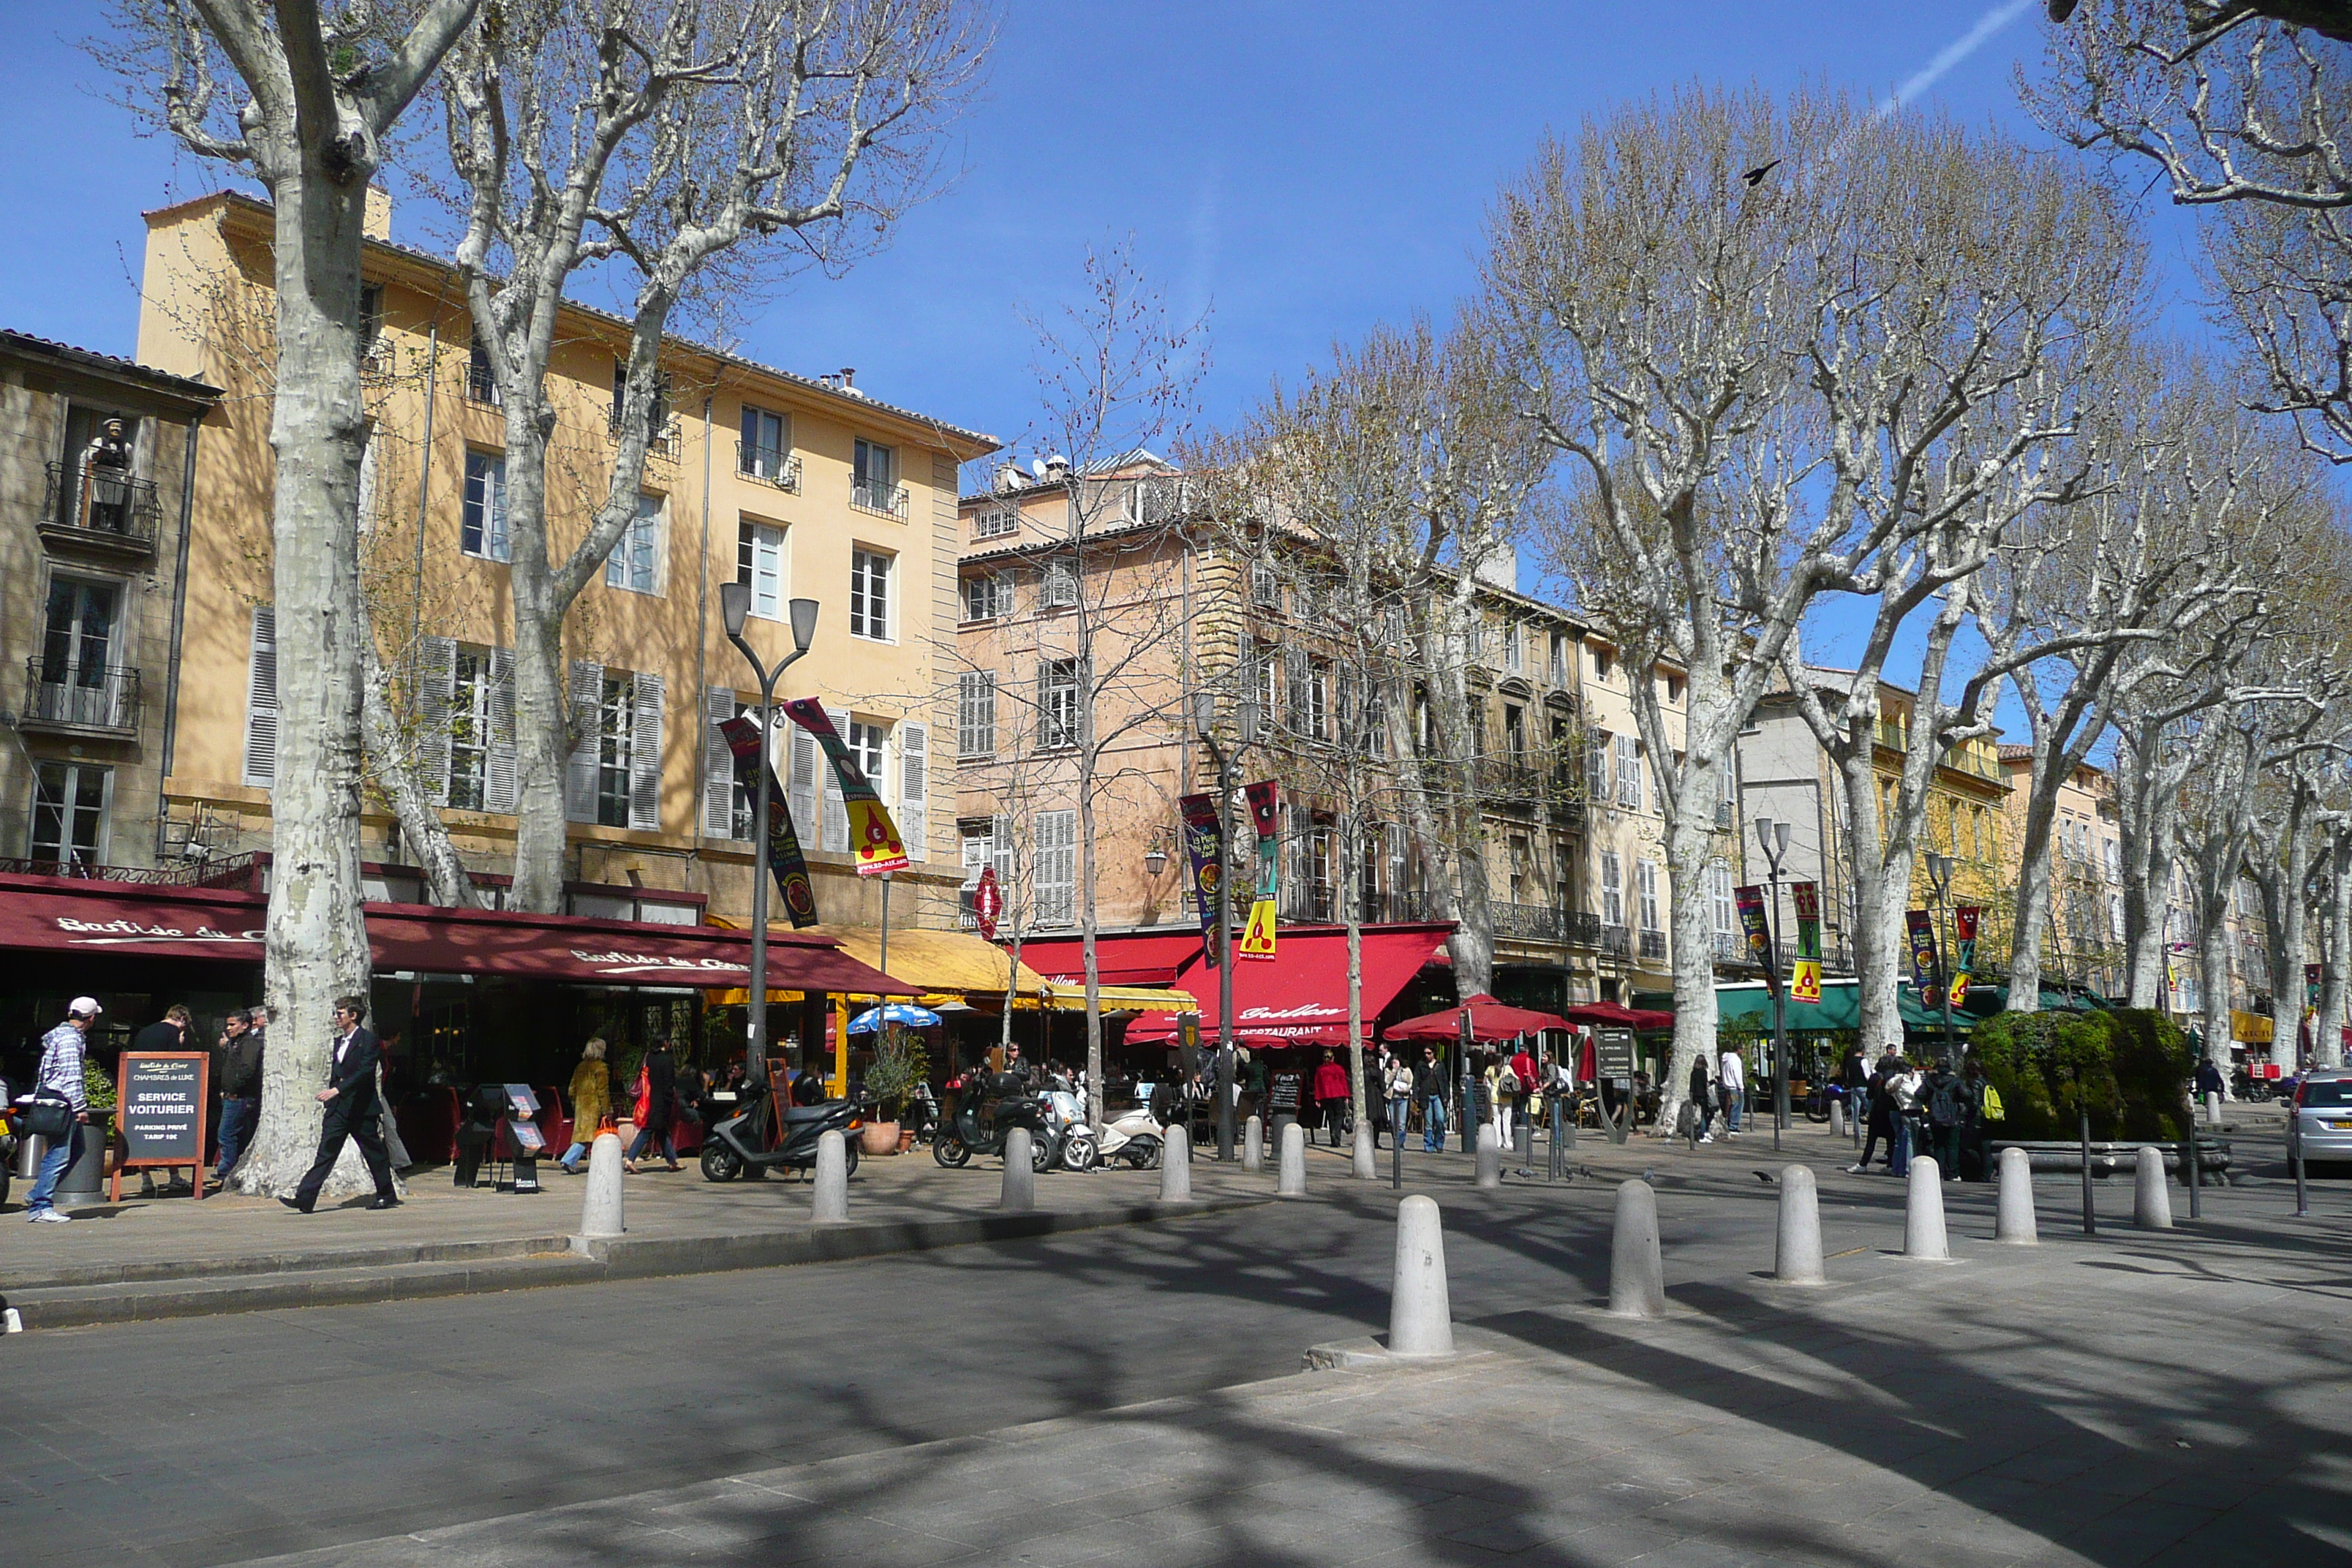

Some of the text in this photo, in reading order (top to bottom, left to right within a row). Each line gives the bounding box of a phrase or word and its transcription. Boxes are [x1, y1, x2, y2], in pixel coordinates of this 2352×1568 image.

[58, 917, 184, 937] Bastide
[195, 926, 233, 939] du
[570, 949, 663, 965] Bastide
[668, 956, 696, 968] du
[1239, 1003, 1347, 1019] Grillon
[137, 1093, 186, 1101] SERVICE
[129, 1105, 194, 1115] VOITURIER
